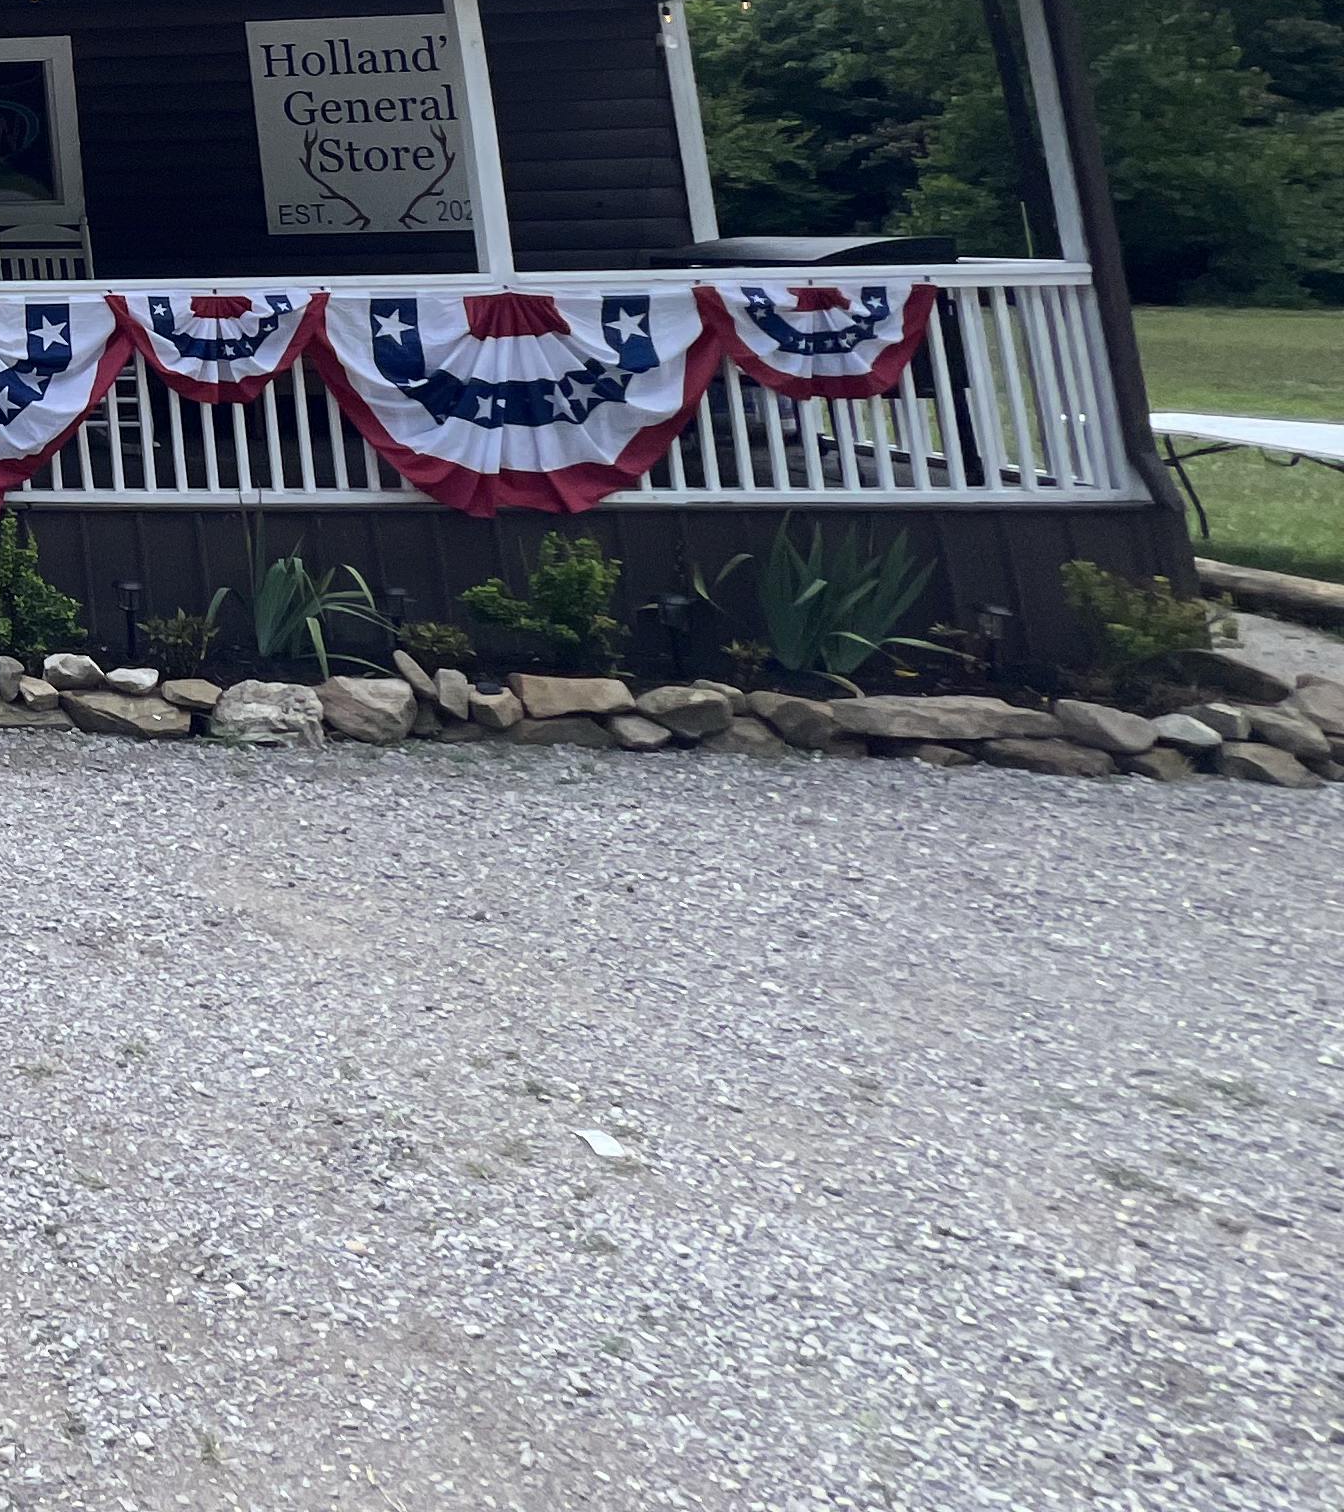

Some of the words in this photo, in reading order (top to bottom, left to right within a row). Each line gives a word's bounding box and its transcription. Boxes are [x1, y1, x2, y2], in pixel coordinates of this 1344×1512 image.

[260, 35, 448, 78] Holland'
[283, 84, 458, 126] General
[318, 138, 436, 173] Store
[278, 203, 333, 226] EST.
[436, 199, 474, 222] 202
